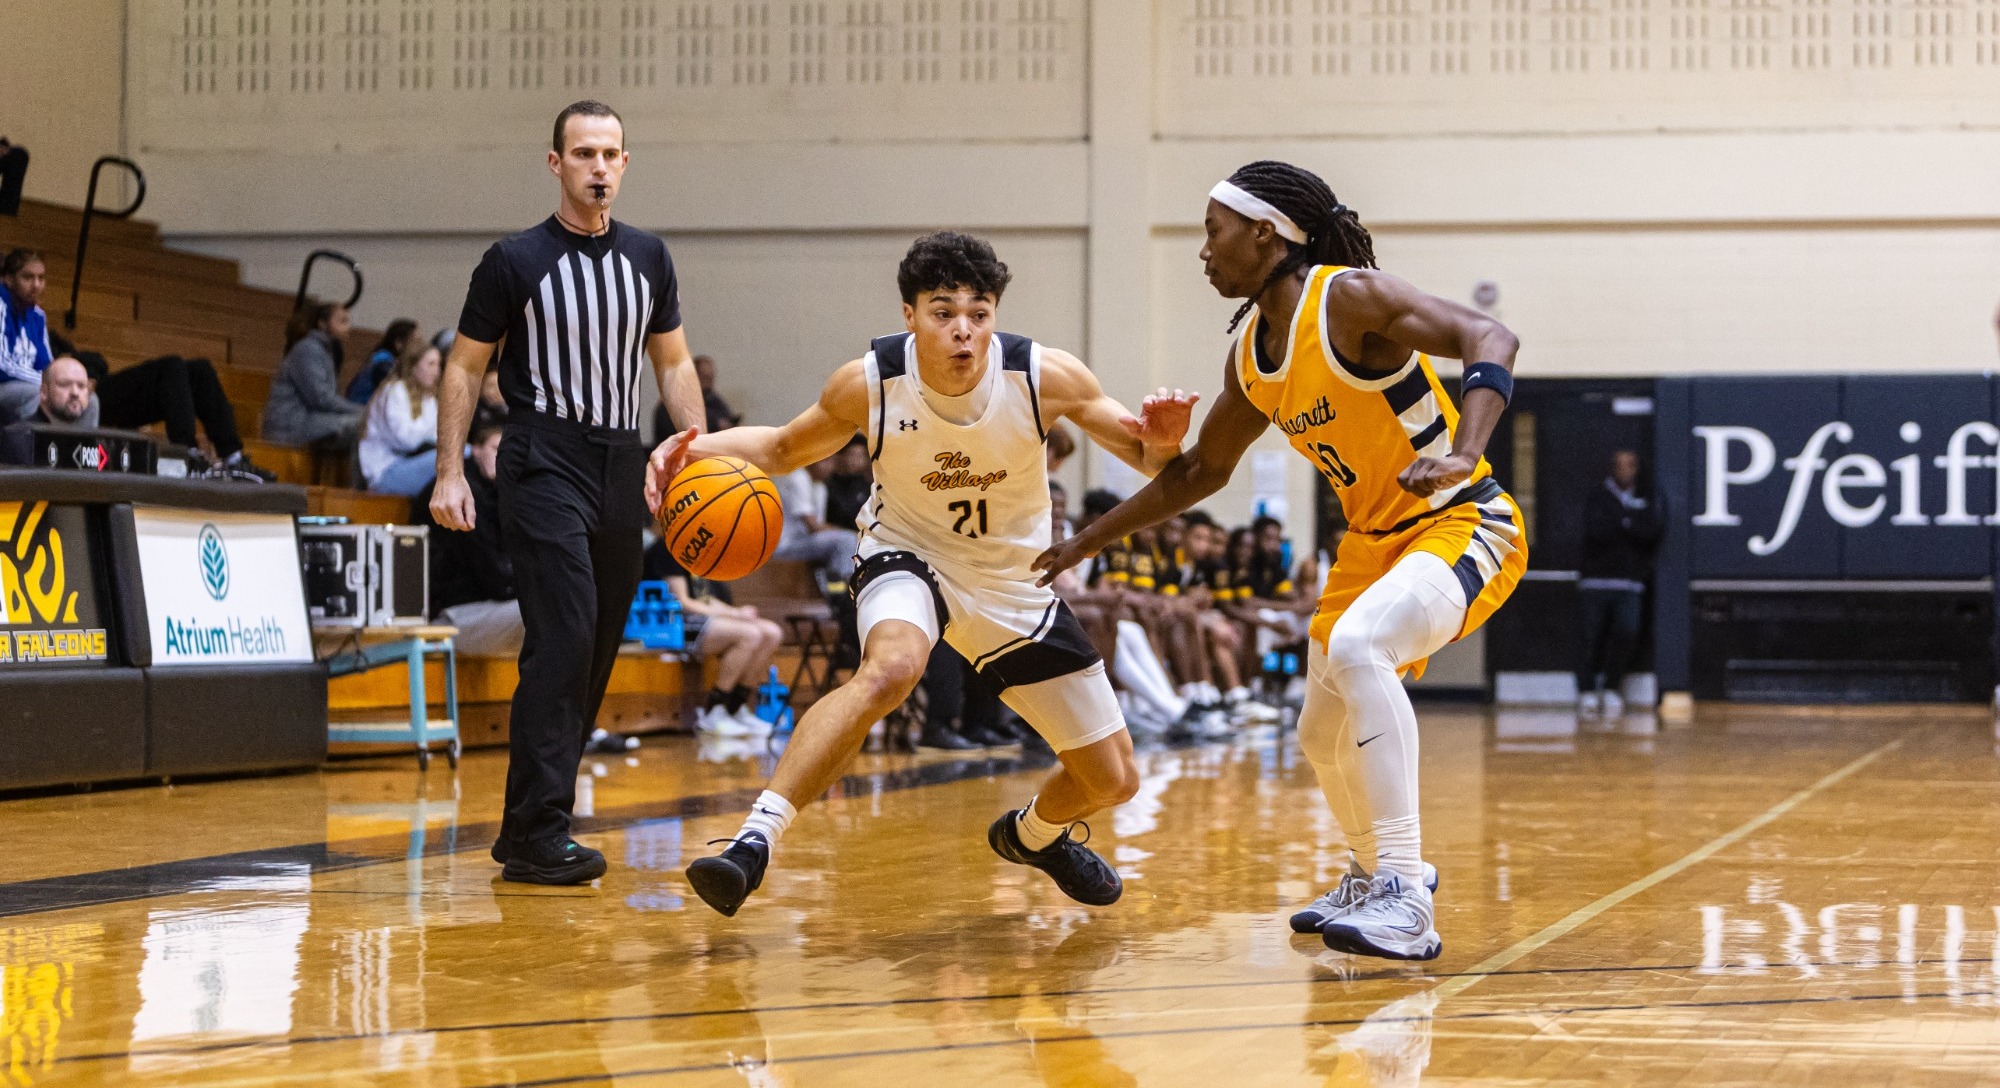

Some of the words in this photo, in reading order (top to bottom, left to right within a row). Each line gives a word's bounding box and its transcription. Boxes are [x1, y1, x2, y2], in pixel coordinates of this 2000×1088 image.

[1272, 394, 1337, 437] Averett
[920, 469, 1008, 491] Village
[934, 451, 971, 470] The
[1691, 420, 2000, 556] Pfeif
[661, 490, 700, 532] lson
[948, 498, 989, 539] 21
[679, 526, 714, 567] NCAA
[13, 629, 107, 662] FALCONS
